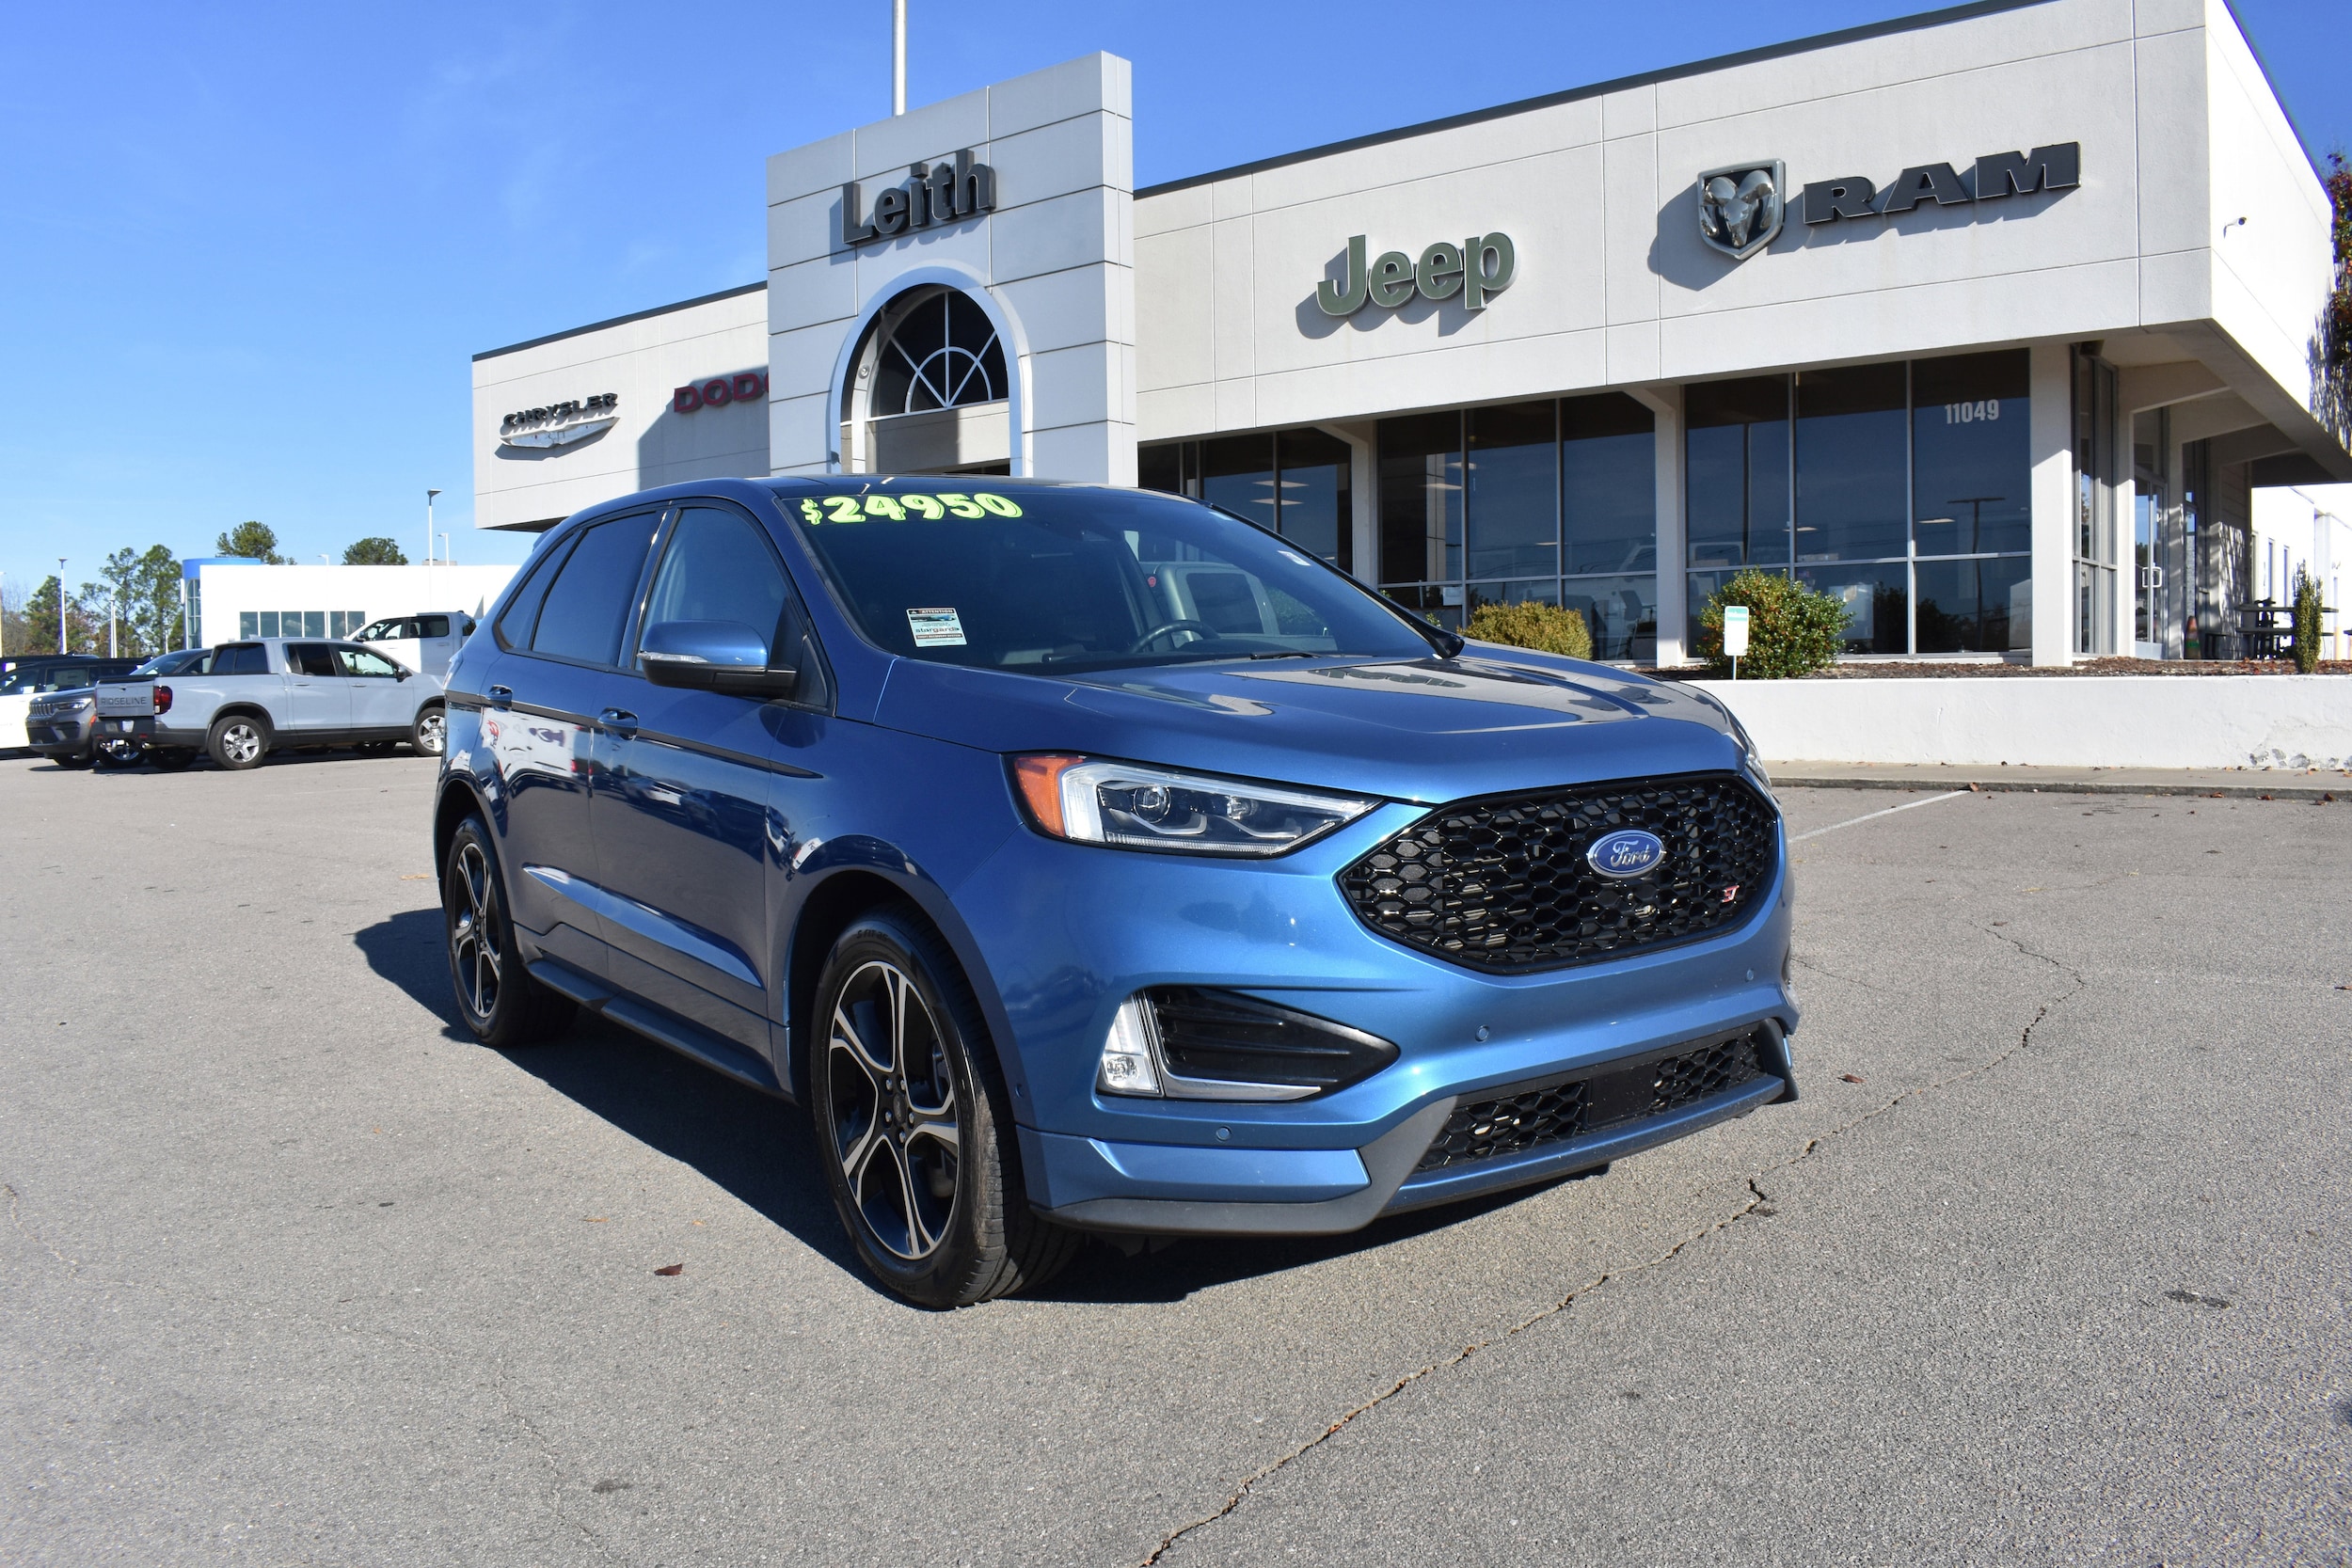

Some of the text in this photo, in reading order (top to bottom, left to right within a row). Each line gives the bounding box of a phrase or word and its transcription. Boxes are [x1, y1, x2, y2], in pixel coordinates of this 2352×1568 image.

[842, 149, 996, 246] Leith
[1803, 141, 2082, 226] RAM
[1316, 230, 1518, 316] Jeep
[503, 393, 618, 425] CHRYSLER
[674, 372, 769, 413] DOD
[1945, 399, 1999, 424] 11049
[801, 493, 1023, 526] $24950
[100, 696, 148, 705] RIDGELINE
[1611, 839, 1650, 868] Ford
